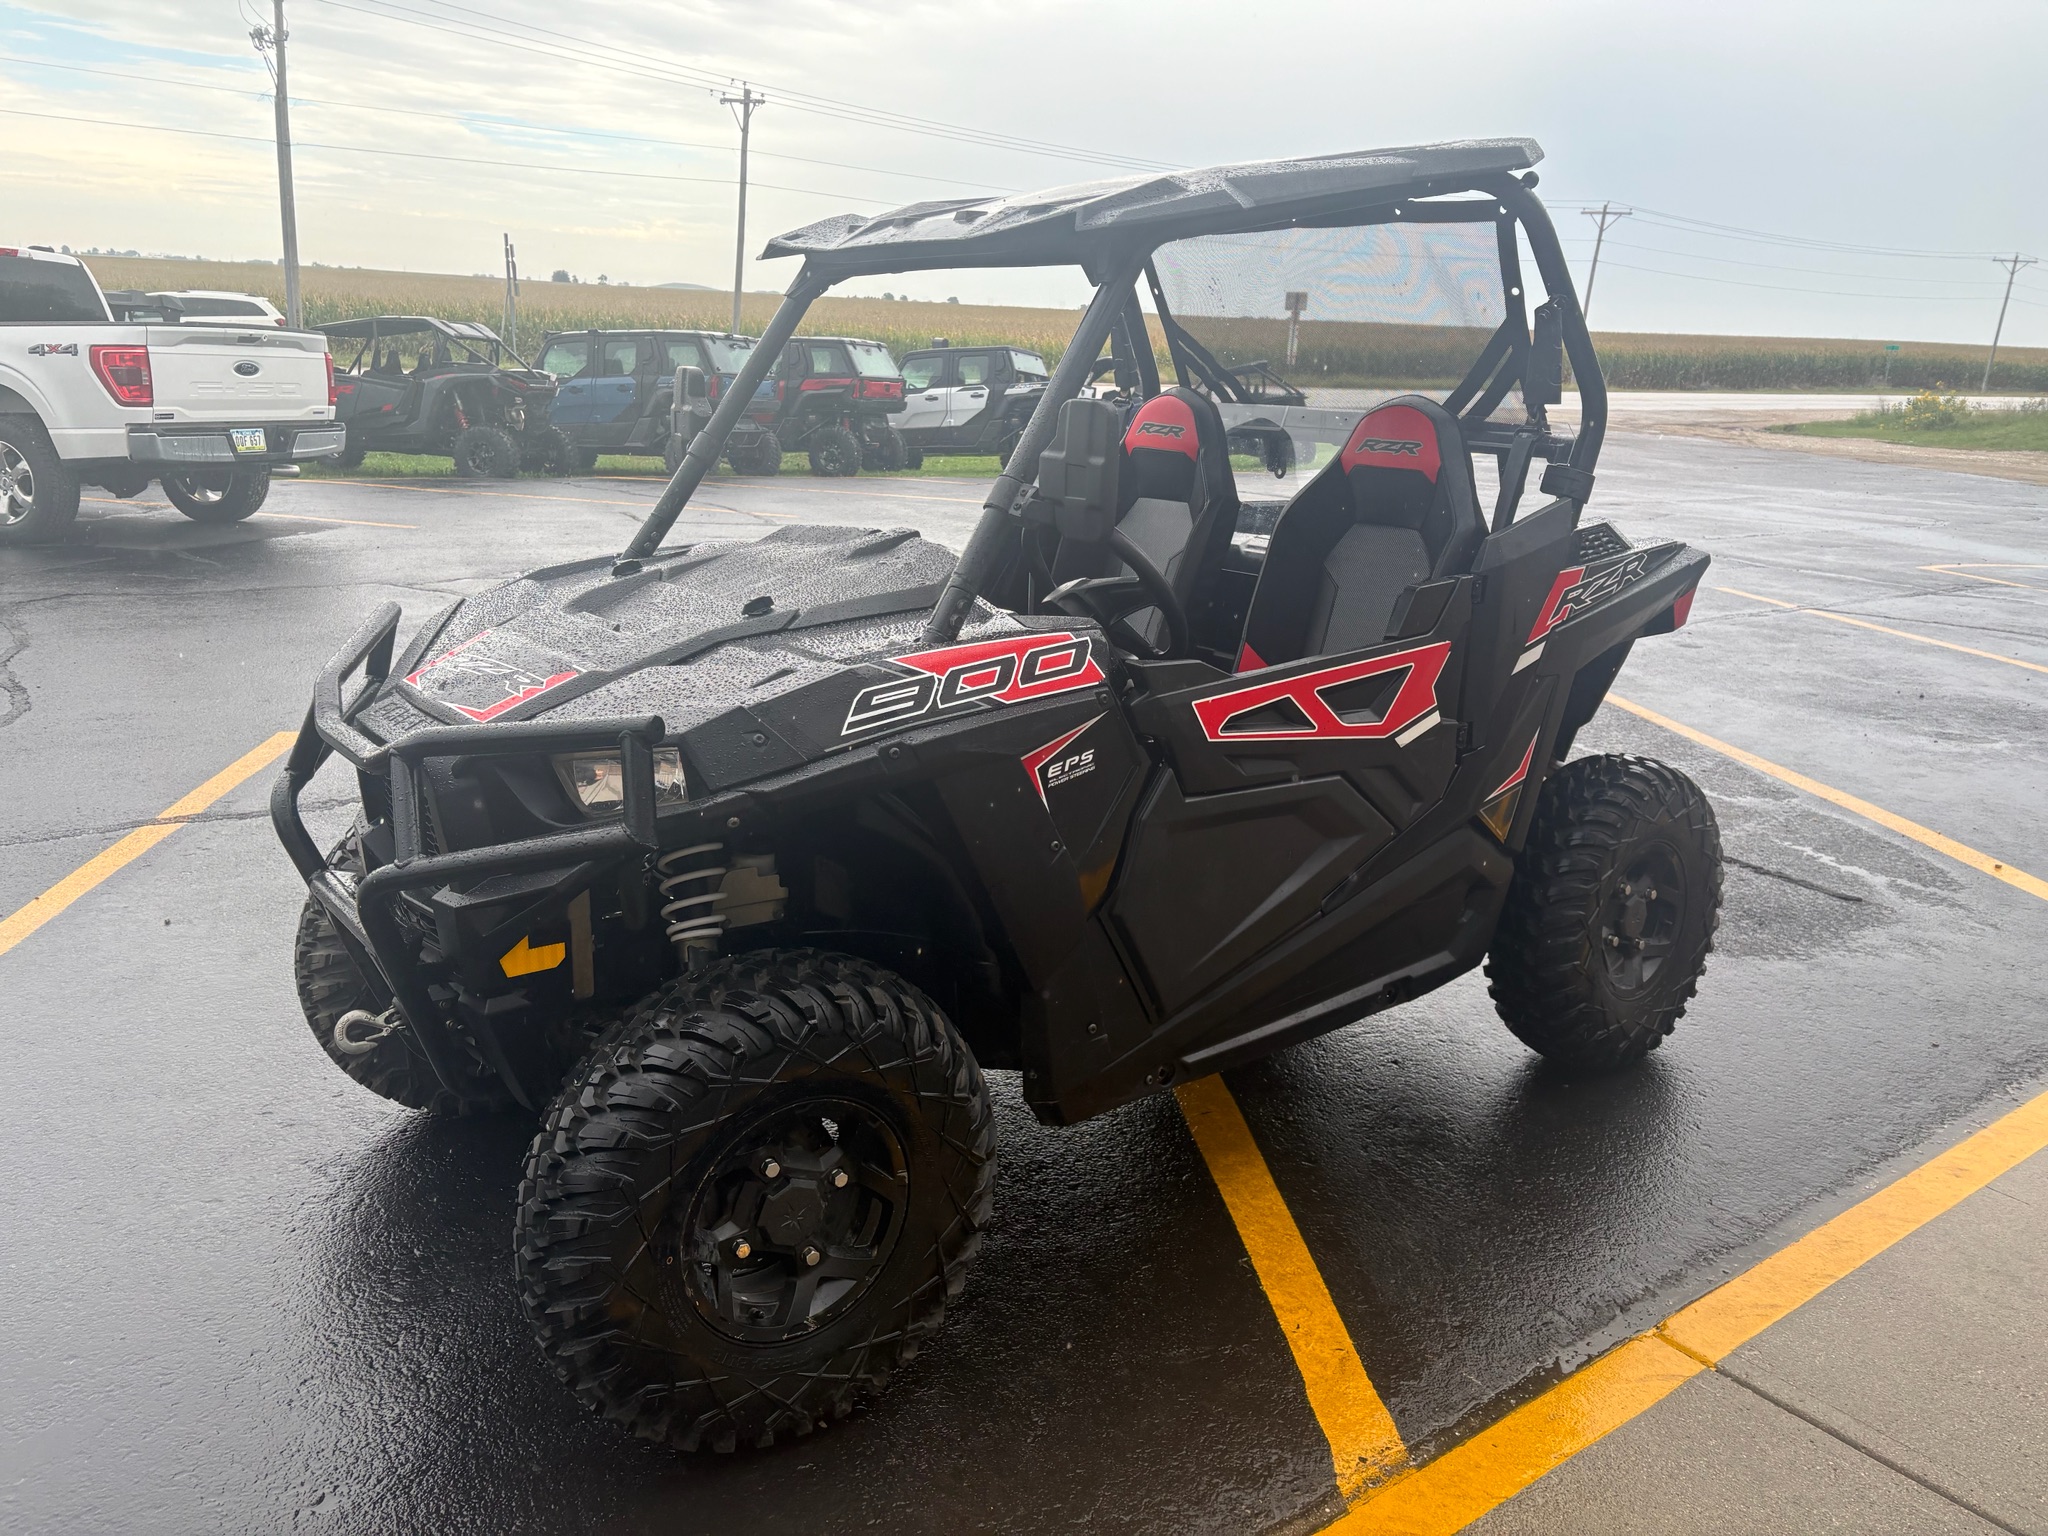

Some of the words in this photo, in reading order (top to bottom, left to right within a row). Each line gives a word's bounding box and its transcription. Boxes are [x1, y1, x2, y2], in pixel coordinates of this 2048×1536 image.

[189, 381, 302, 397] F-150
[1136, 421, 1186, 439] RZR
[1355, 437, 1424, 456] RZR
[1546, 552, 1648, 626] RZR
[841, 636, 1092, 736] 900
[1047, 749, 1095, 778] EPS
[1048, 777, 1069, 788] POWER
